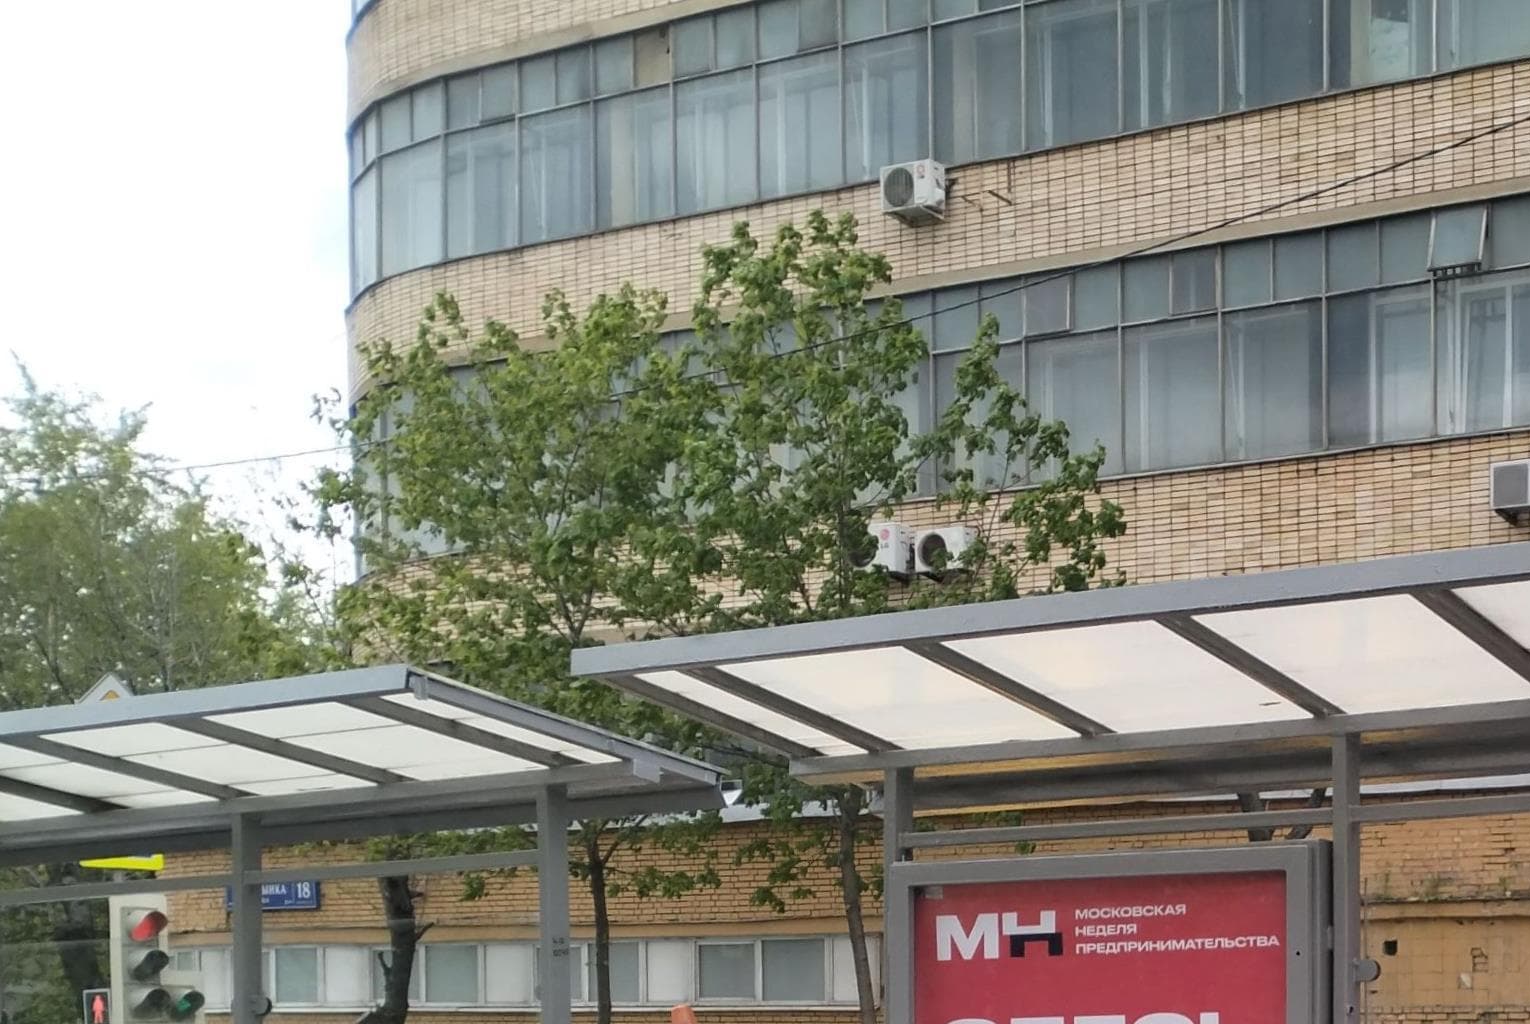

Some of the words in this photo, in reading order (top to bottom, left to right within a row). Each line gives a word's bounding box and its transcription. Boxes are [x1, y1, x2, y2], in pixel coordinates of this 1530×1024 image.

[296, 881, 311, 899] 18
[1075, 903, 1187, 920] МОСКОВСКАЯ
[935, 910, 1064, 961] МН
[1075, 923, 1137, 938] НЕДЕЛЯ
[1075, 935, 1280, 955] ПРЕДПРИНИМАТЕЛЬСТВА
